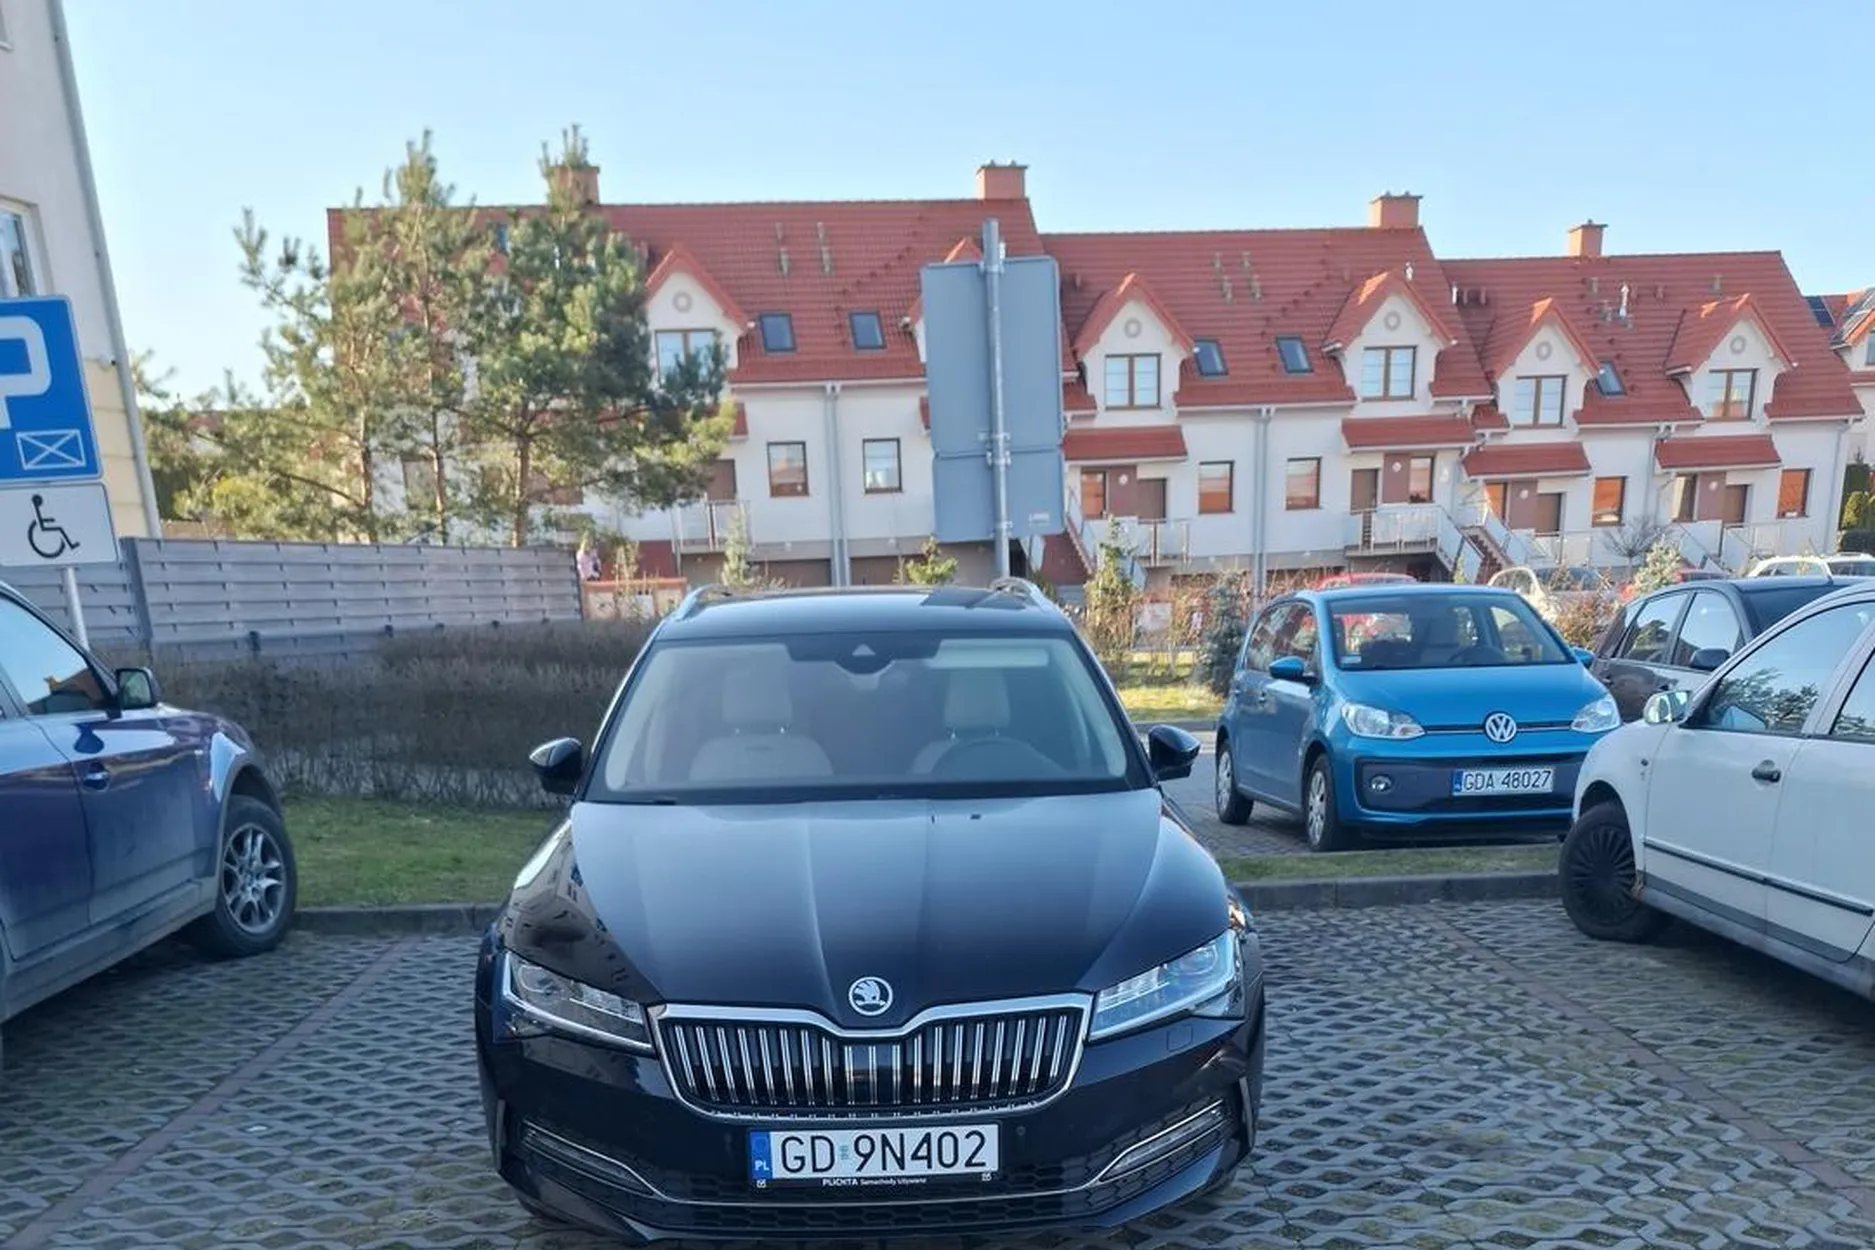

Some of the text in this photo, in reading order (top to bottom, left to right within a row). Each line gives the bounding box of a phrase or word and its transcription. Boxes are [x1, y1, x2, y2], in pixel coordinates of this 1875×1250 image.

[1486, 713, 1516, 742] VW
[1463, 772, 1495, 791] GDA
[1501, 770, 1552, 789] 48027
[781, 1130, 987, 1173] GD 9N402
[755, 1161, 770, 1171] PL
